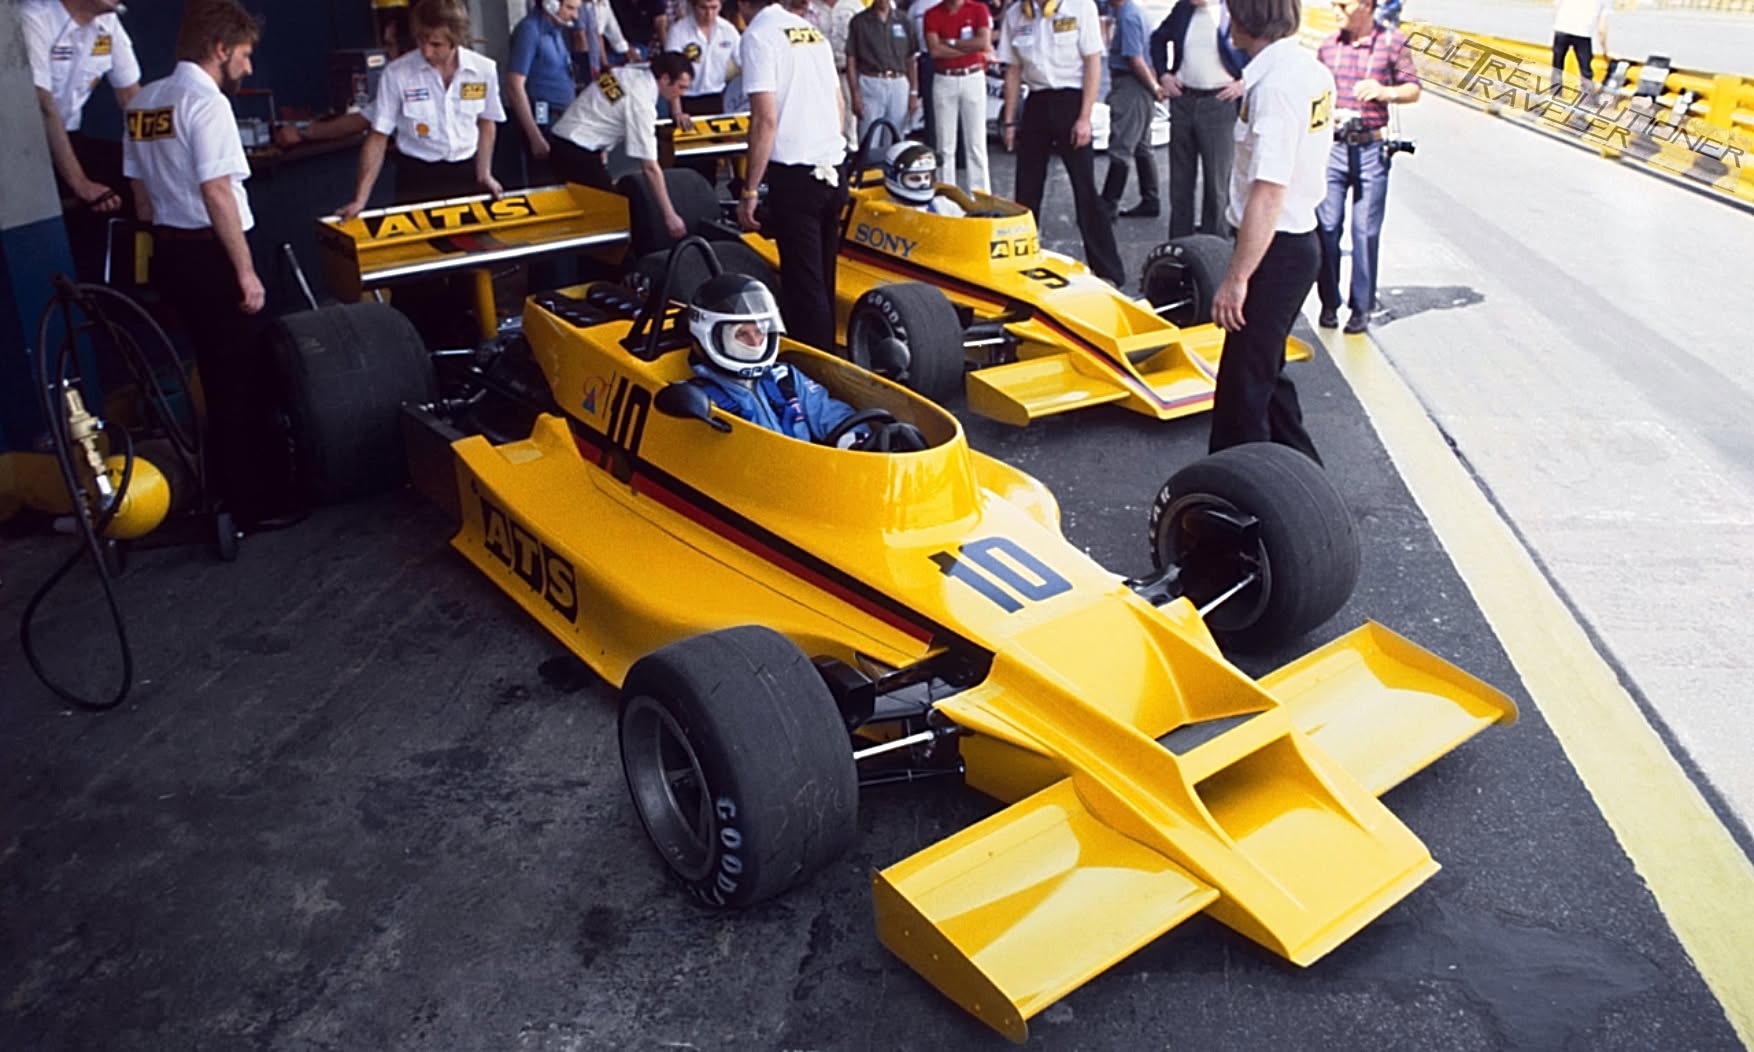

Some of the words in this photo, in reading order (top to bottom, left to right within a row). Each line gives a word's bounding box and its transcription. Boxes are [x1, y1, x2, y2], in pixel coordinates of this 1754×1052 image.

[367, 196, 533, 239] ATS
[855, 223, 918, 257] SONY
[1017, 267, 1070, 289] 9
[601, 376, 653, 482] 10
[482, 500, 577, 620] ATS
[928, 537, 1073, 613] 10
